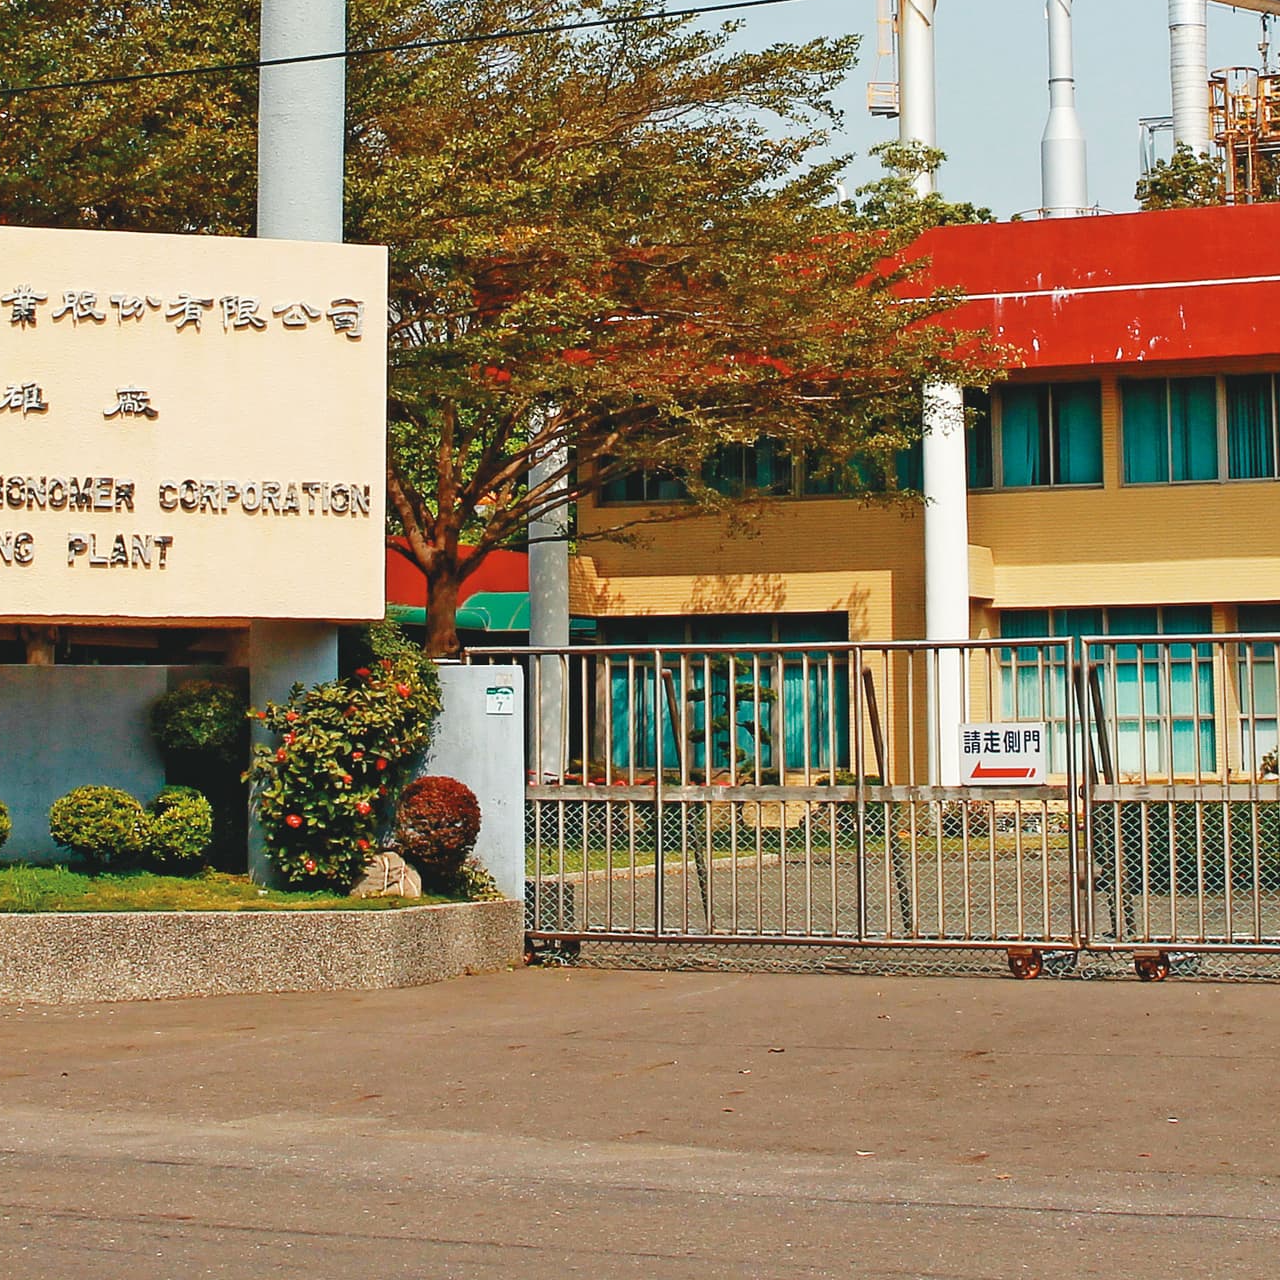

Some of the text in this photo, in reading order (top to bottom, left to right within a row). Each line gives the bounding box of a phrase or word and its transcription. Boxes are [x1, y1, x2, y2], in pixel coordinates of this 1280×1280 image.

[158, 479, 371, 517] CORPORATION
[67, 532, 175, 569] PLANT
[962, 729, 1041, 754] 請走側門
